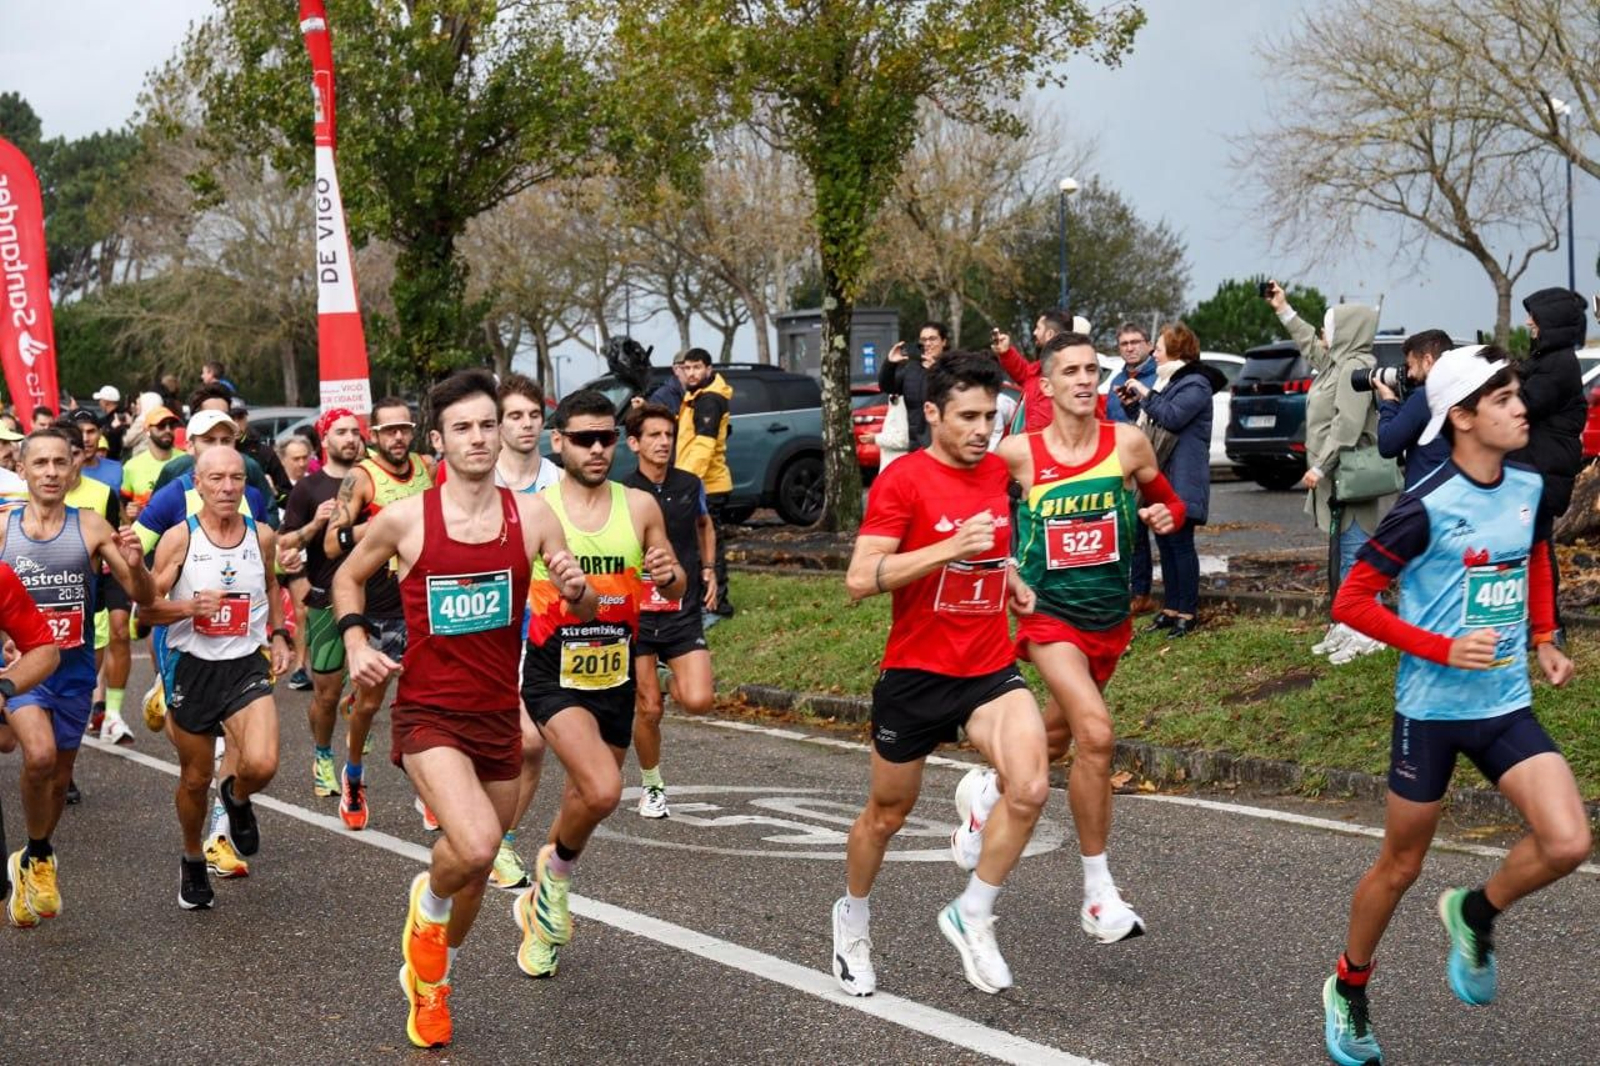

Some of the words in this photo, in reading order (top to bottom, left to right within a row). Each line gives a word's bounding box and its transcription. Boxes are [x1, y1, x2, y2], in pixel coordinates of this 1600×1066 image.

[317, 178, 334, 241] VIGO
[320, 251, 339, 283] DE
[1041, 491, 1114, 517] BIKILA
[1062, 530, 1102, 553] 522
[576, 555, 625, 575] ORTH
[20, 570, 84, 587] astrelos
[973, 578, 984, 600] 1
[440, 590, 500, 618] 4002
[571, 651, 621, 674] 2016
